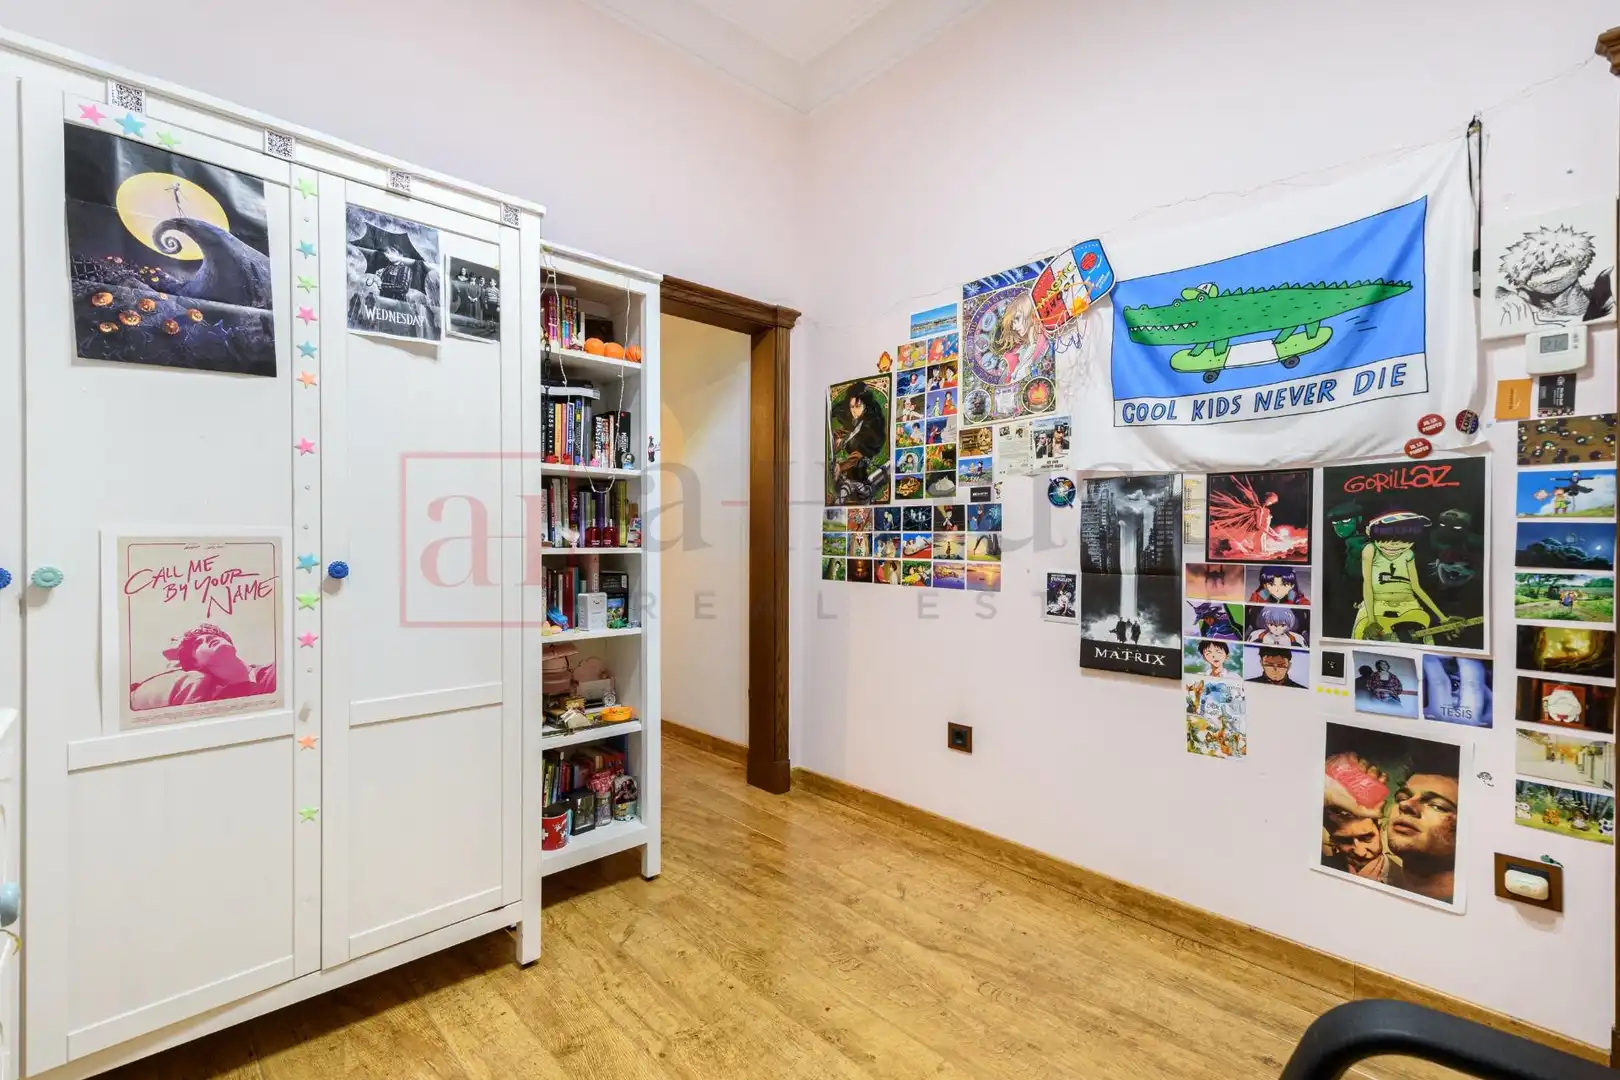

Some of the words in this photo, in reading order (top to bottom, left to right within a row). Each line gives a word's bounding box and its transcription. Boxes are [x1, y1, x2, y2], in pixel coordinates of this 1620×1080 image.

[364, 306, 424, 327] WEDNESDAY
[1122, 402, 1178, 423] COOL
[1191, 395, 1242, 422] KIDS
[1254, 379, 1338, 413] NEVER
[1353, 363, 1408, 396] DIE
[124, 565, 184, 595] CALL
[187, 554, 220, 584] ME
[163, 583, 188, 603] BY
[194, 568, 260, 603] YOUR
[206, 575, 280, 619] NAME
[1094, 646, 1167, 666] MATRIX
[1440, 706, 1473, 720] TESIS
